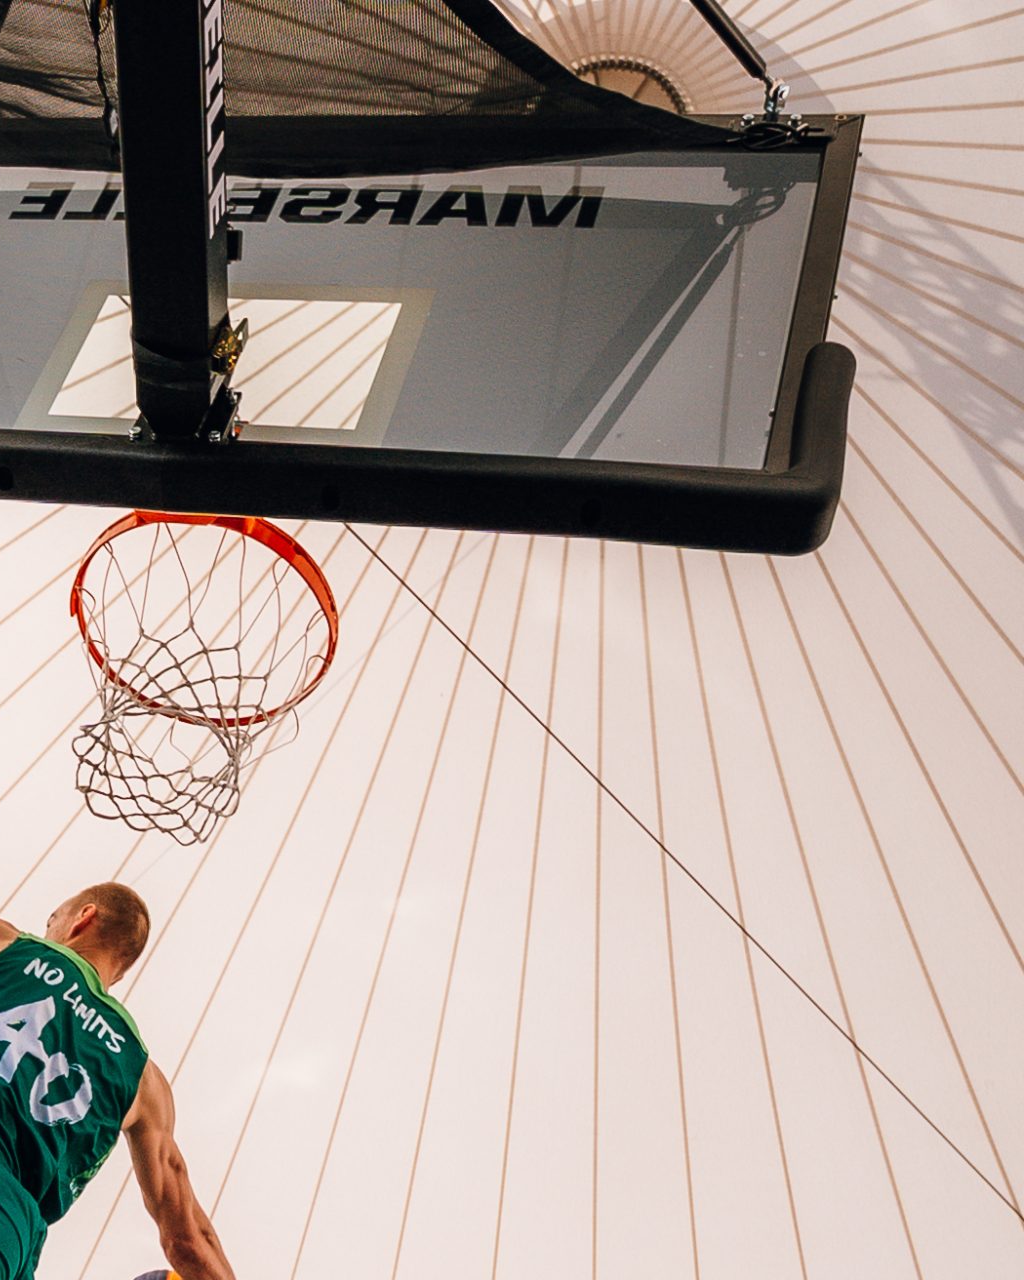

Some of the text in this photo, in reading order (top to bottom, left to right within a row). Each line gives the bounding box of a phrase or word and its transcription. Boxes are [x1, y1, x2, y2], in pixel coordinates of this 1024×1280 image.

[204, 0, 226, 240] EILLE
[23, 957, 127, 1054] NO LIMITS
